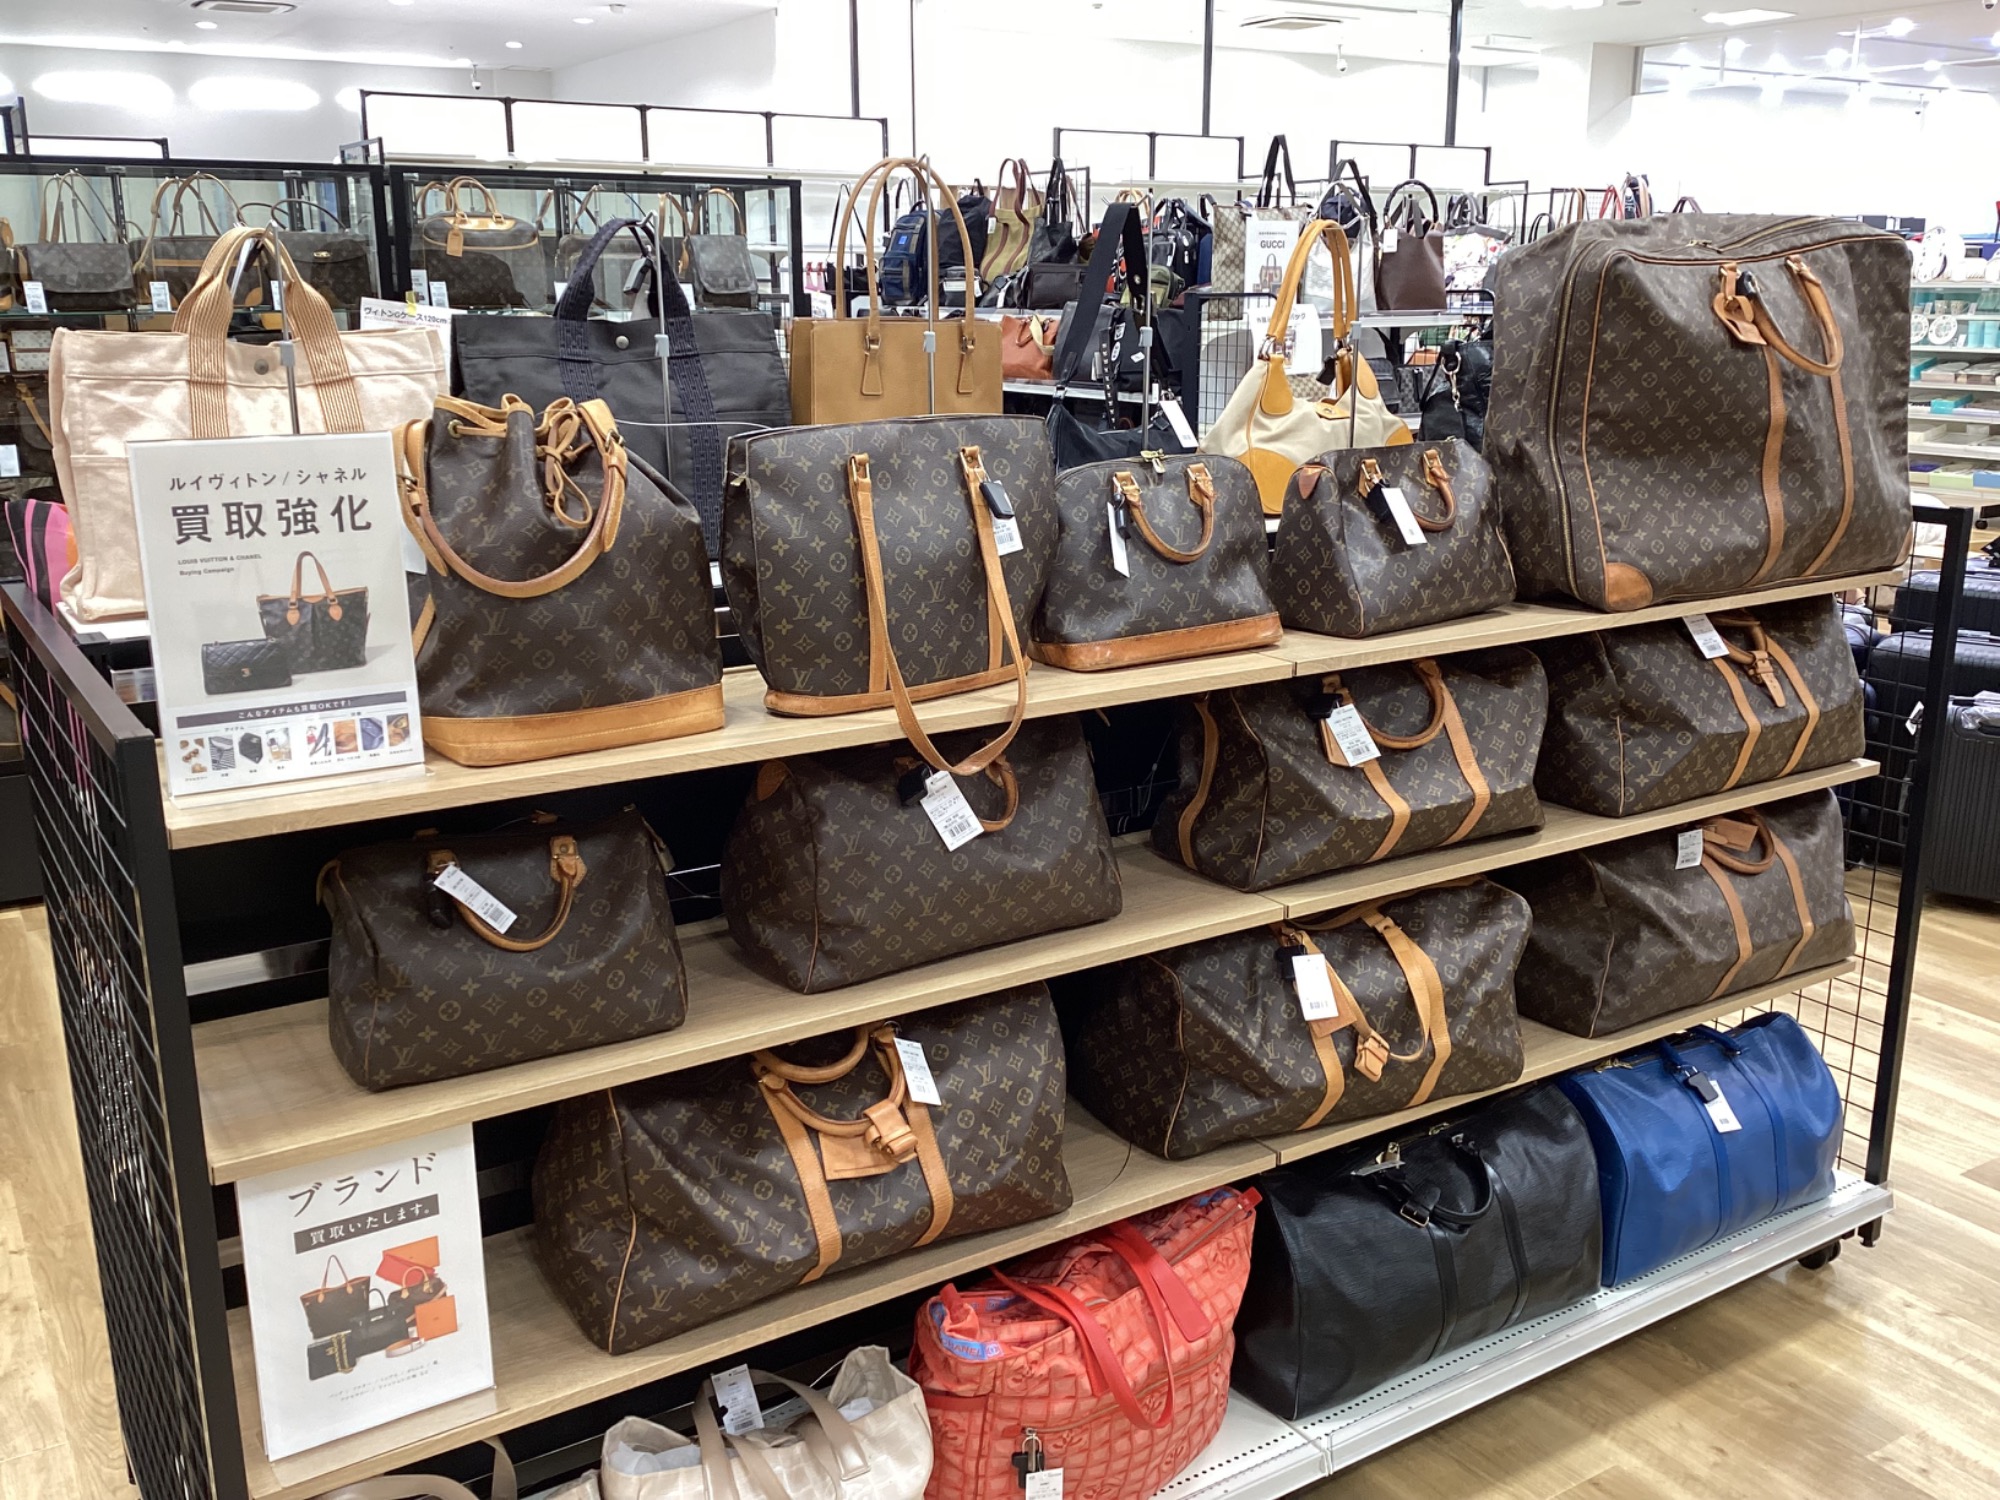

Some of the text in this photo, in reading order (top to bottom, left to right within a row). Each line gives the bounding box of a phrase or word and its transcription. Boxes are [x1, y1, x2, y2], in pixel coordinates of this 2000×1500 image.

[1260, 240, 1285, 249] GUCCI
[171, 494, 372, 545] 買取強化
[288, 1152, 437, 1218] ブランド
[310, 1202, 431, 1246] 買取いたします。
